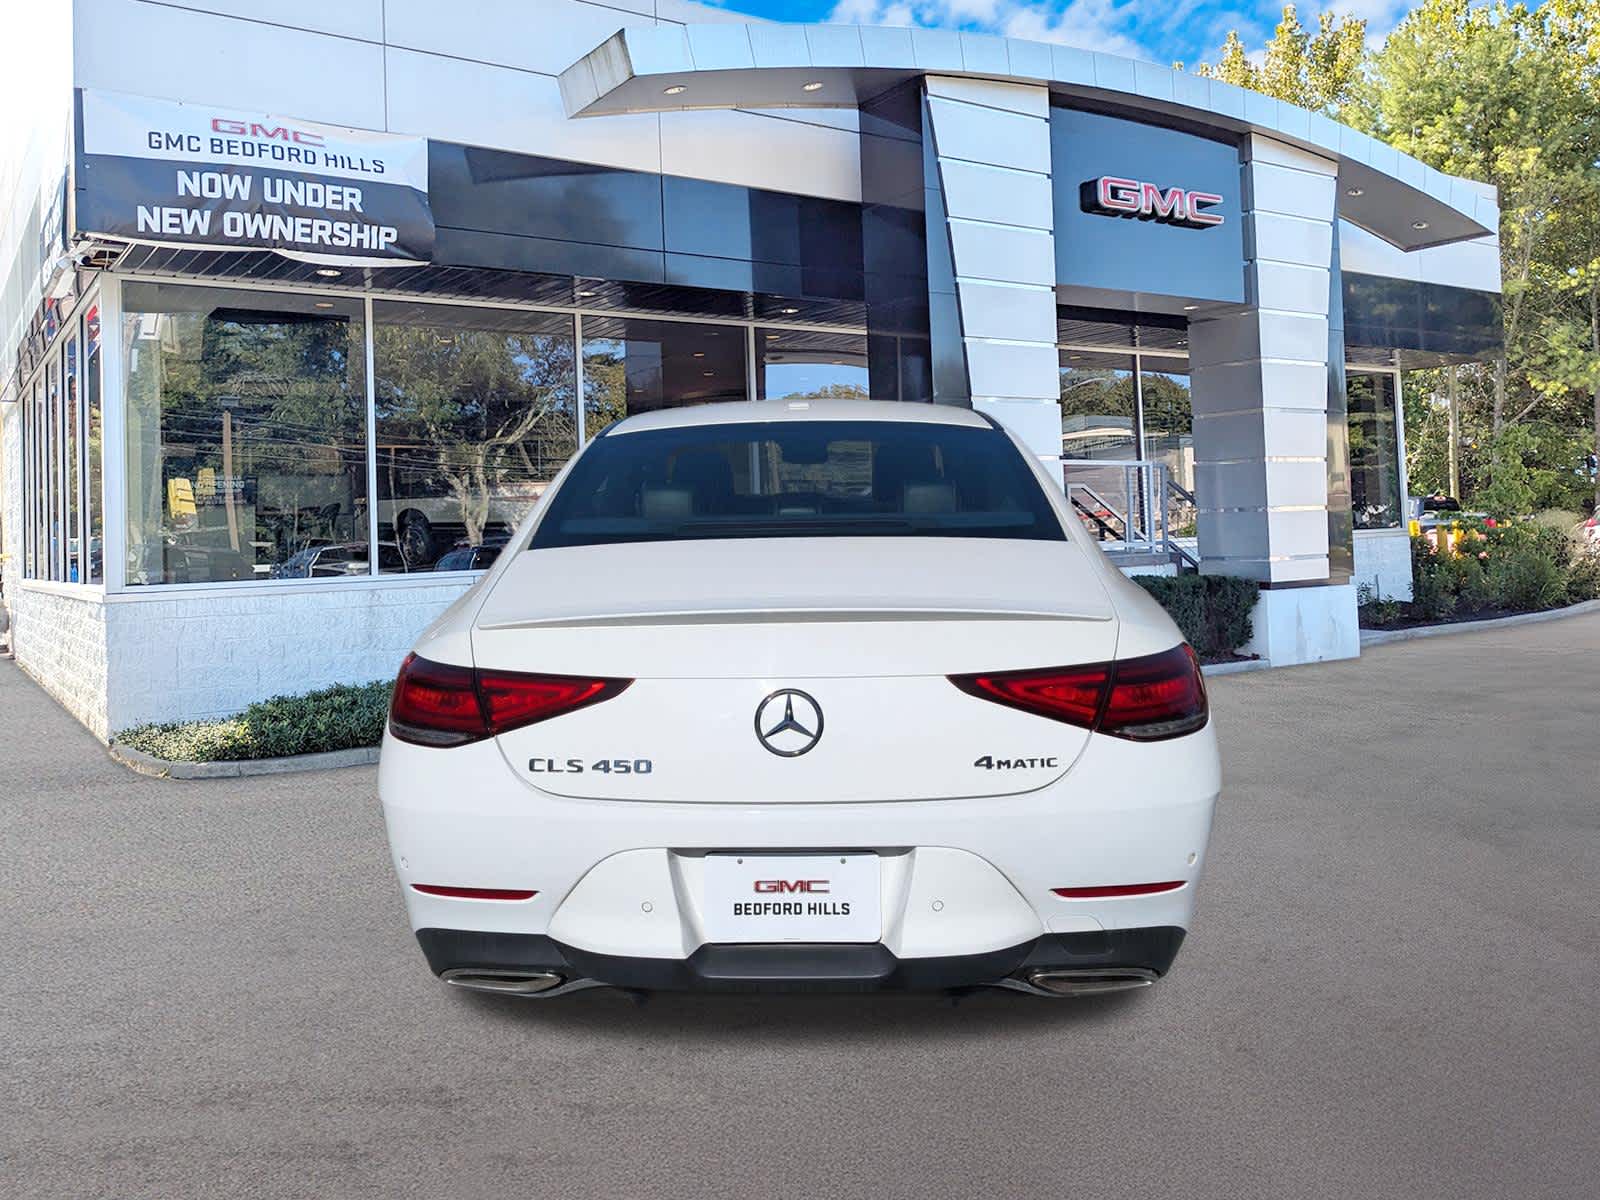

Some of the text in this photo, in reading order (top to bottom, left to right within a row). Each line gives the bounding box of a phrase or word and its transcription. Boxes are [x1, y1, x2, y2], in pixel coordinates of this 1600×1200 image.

[210, 117, 326, 148] GMC
[147, 130, 386, 175] GMC BEDFORD HILLS
[176, 169, 364, 213] NOW UNDER
[1096, 175, 1225, 225] GMC
[136, 205, 399, 251] NEW OWNERSHIP
[528, 758, 653, 774] CLS 450
[973, 755, 1059, 770] 4MATIC
[753, 879, 831, 893] GMC
[733, 902, 851, 916] BEDFORD HILLS
